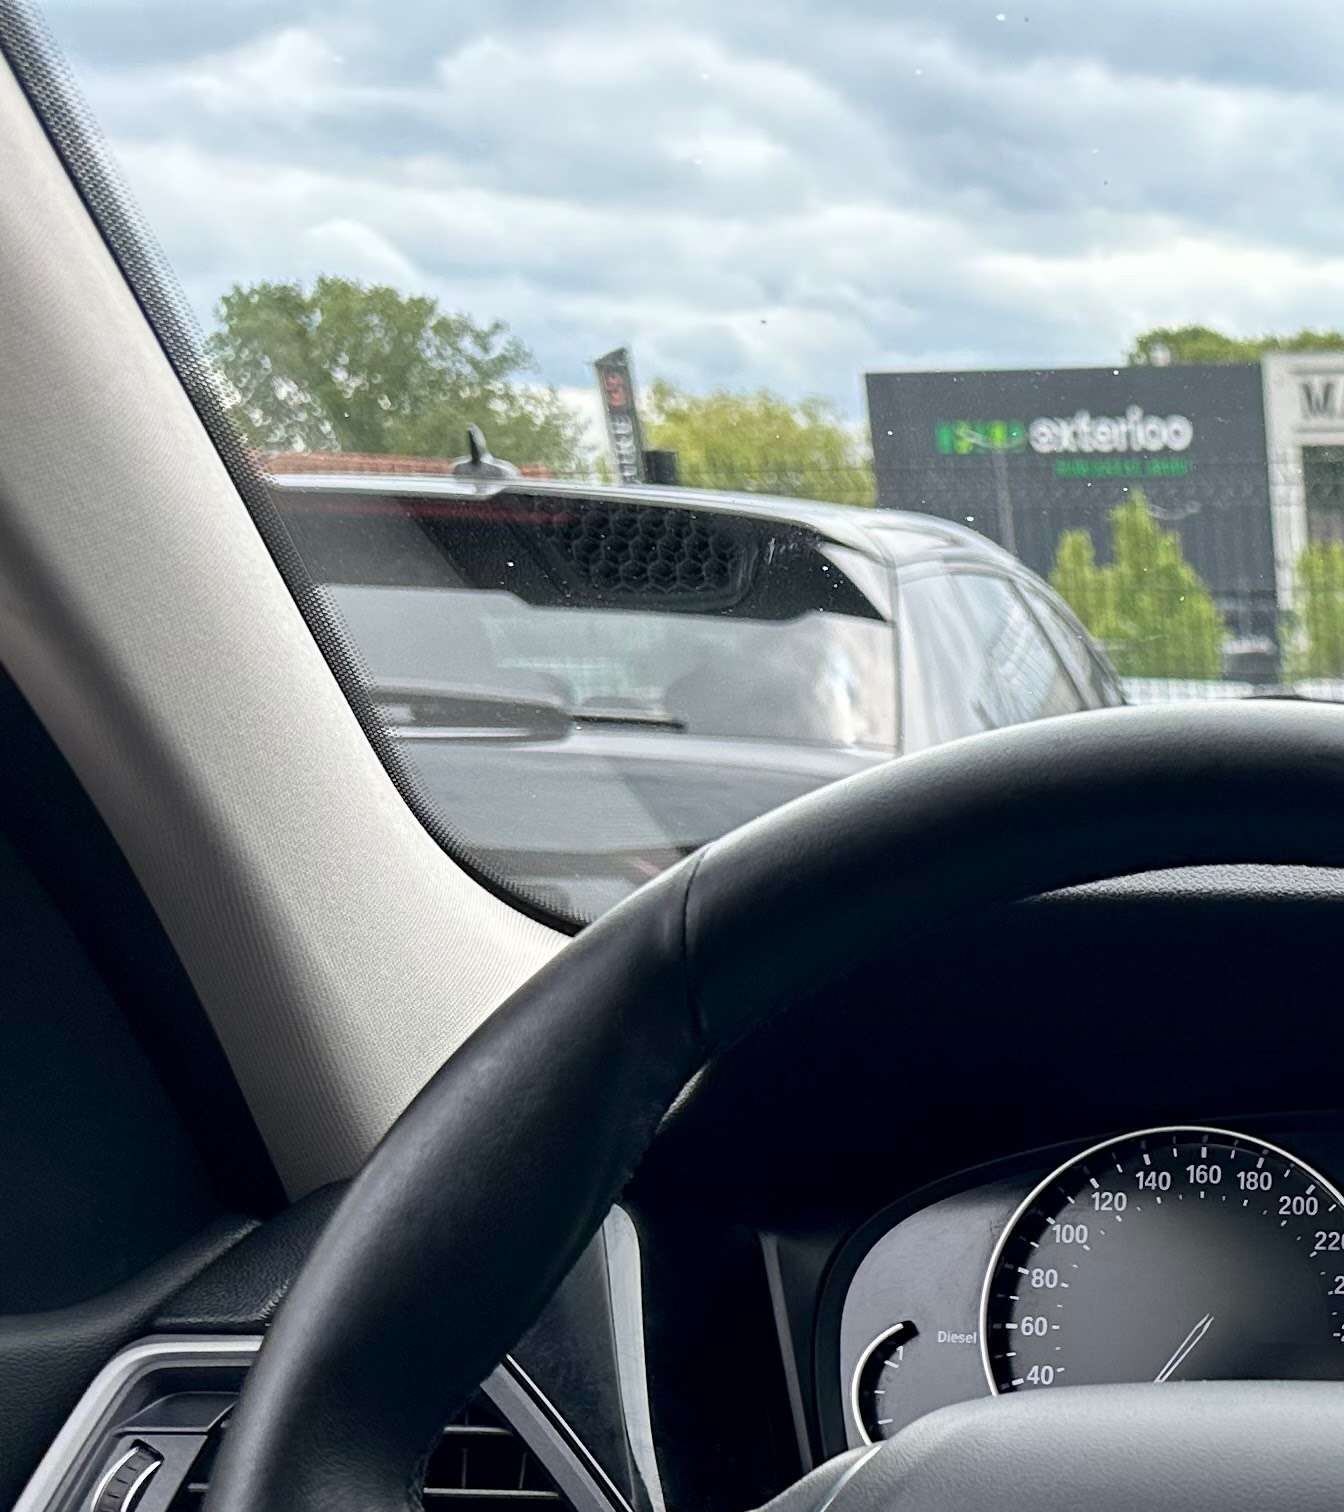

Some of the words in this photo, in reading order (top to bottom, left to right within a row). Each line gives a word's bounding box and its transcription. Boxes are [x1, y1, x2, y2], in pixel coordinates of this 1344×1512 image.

[1028, 405, 1194, 453] exterioo
[1134, 1169, 1172, 1192] 140
[1185, 1164, 1222, 1185] 160
[1236, 1171, 1273, 1192] 180
[1091, 1191, 1127, 1213] 120
[1278, 1195, 1319, 1217] 200
[1052, 1224, 1089, 1245] 100
[1030, 1268, 1059, 1289] 80
[937, 1330, 977, 1344] Diesel
[1020, 1316, 1048, 1337] 60
[1026, 1364, 1055, 1385] 40
